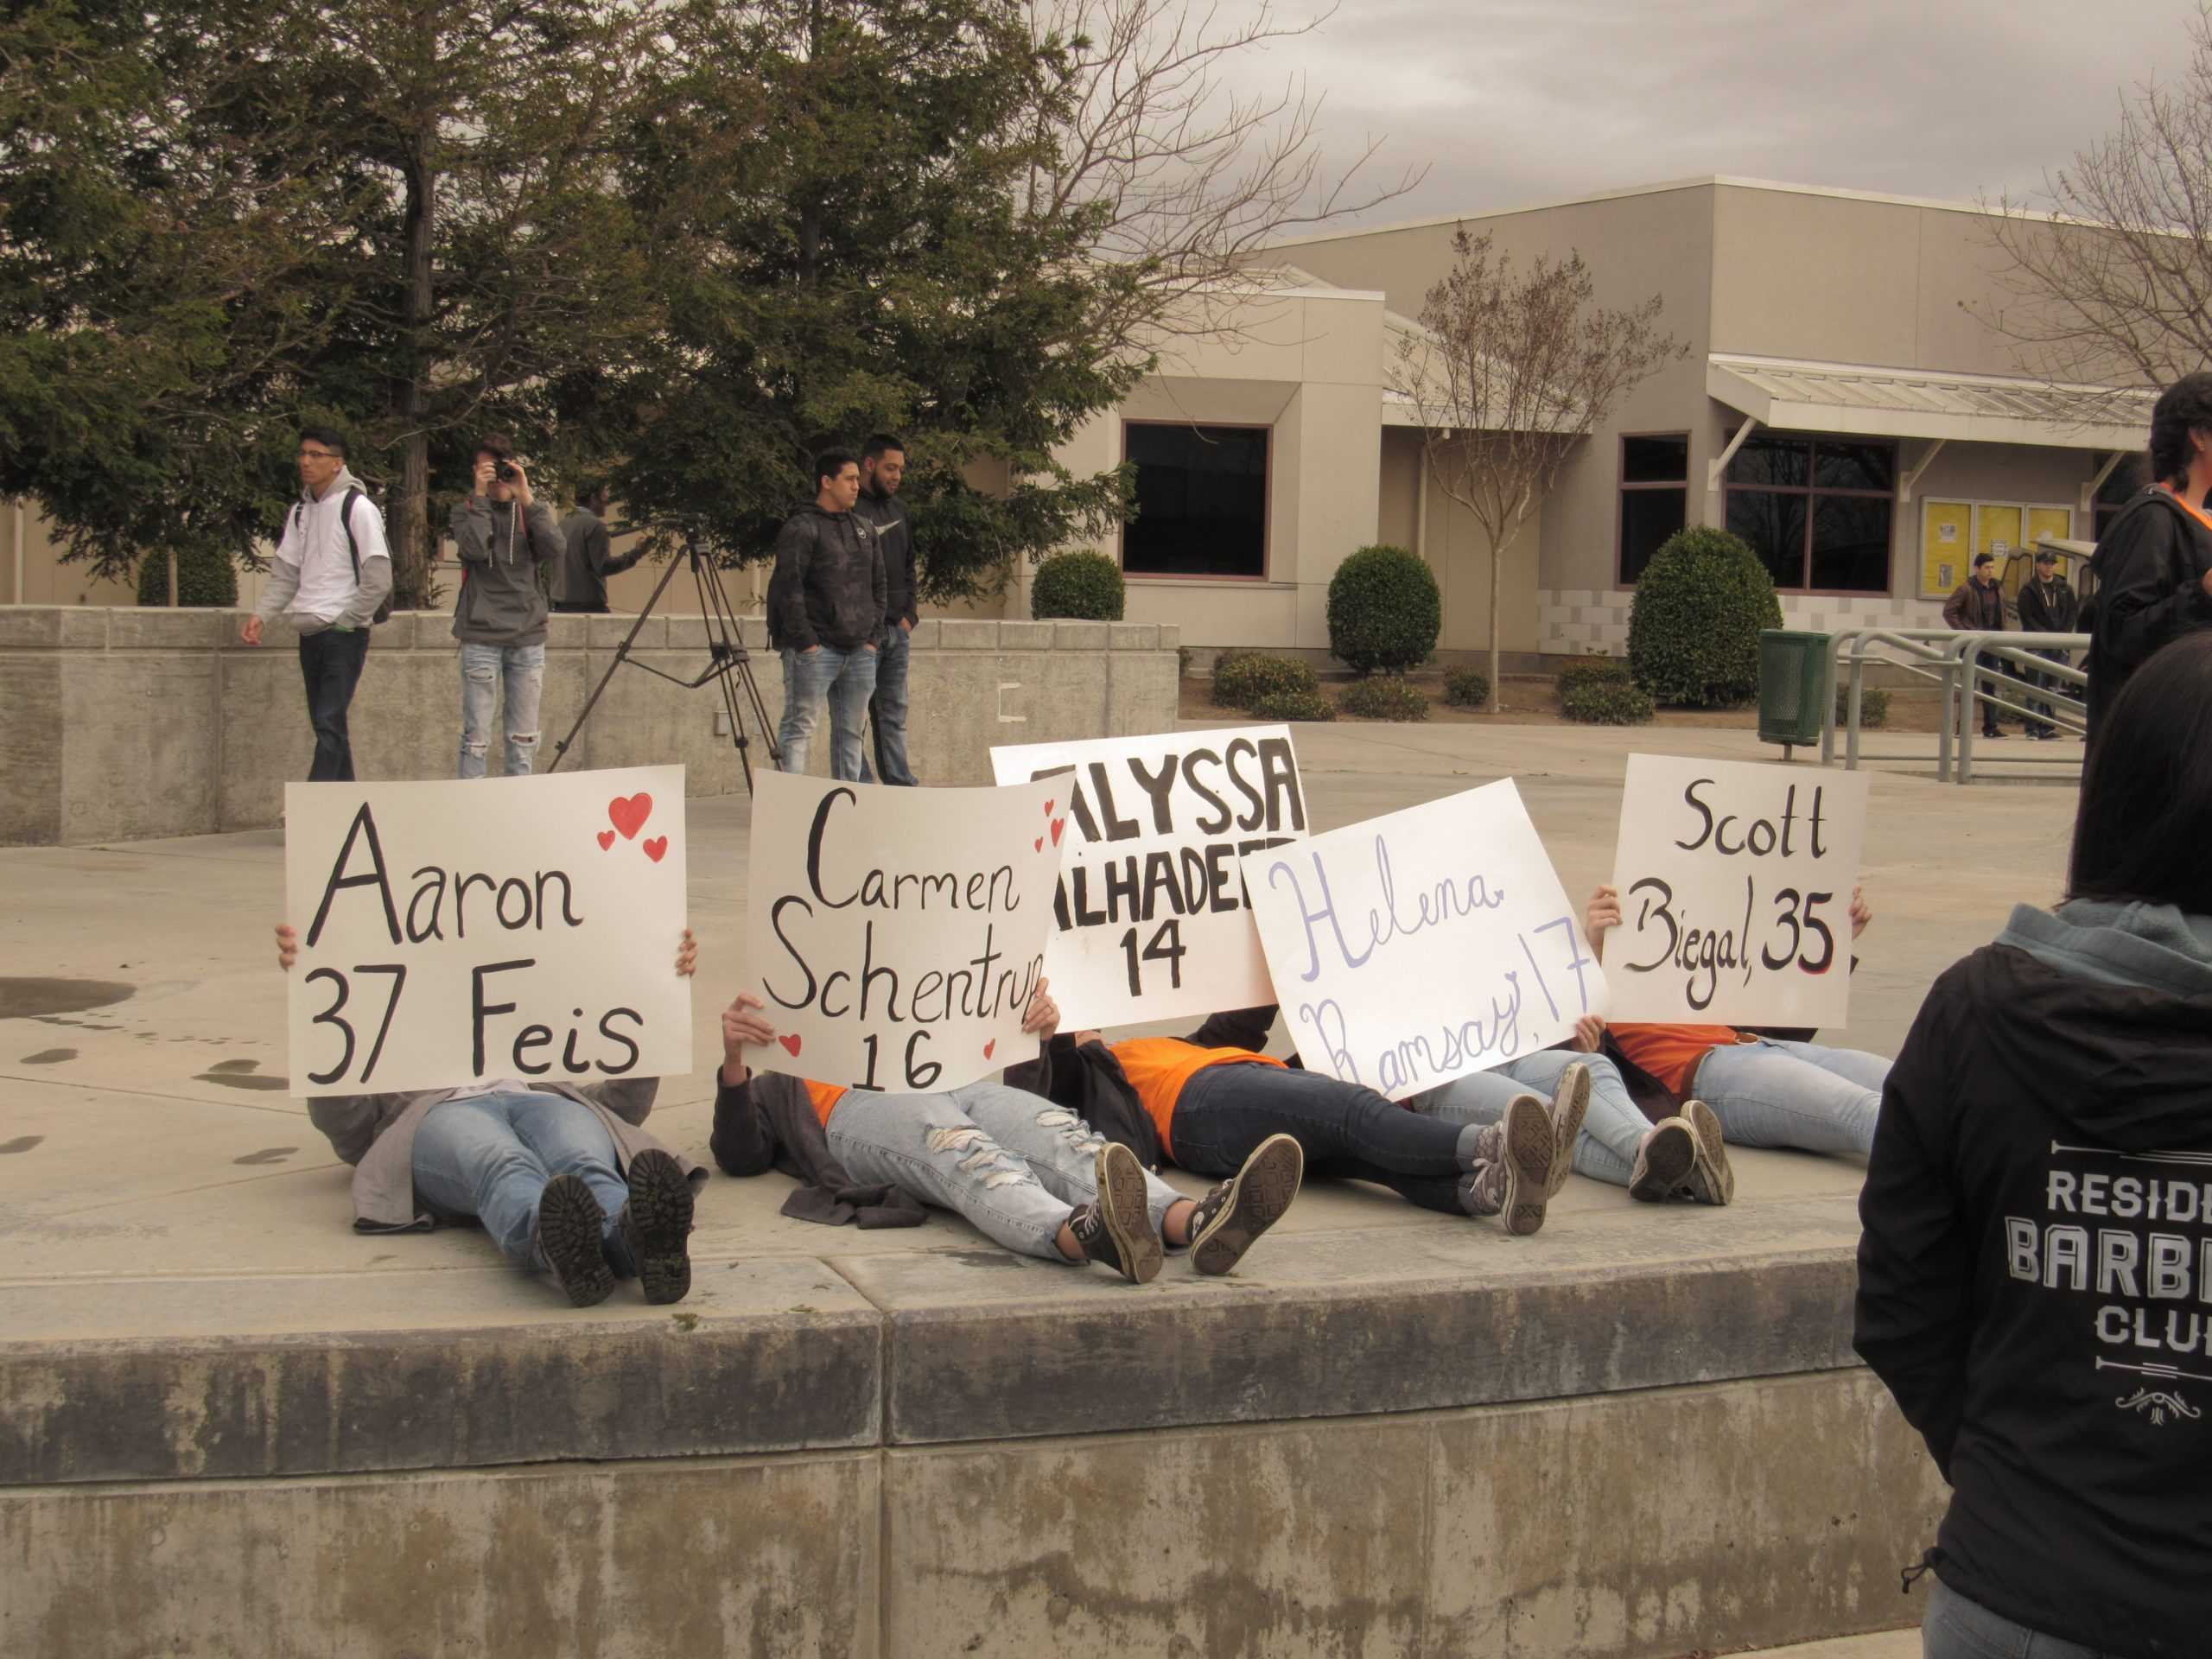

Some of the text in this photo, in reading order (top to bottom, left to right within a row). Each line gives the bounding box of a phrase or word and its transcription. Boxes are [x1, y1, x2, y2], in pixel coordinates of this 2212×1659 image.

[806, 786, 1021, 913] Carmen
[1674, 779, 1827, 859] Scott
[306, 800, 584, 947] Aaron
[1053, 837, 1297, 931] LHADE
[1268, 834, 1504, 982] Helena
[762, 894, 1045, 1026] Schentrup
[1119, 918, 1187, 997] 14
[1518, 916, 1591, 1023] 17
[1761, 887, 1834, 976] 35
[304, 958, 645, 1086] 37 Feis
[851, 1029, 943, 1092] 16
[2045, 1169, 2212, 1224] RESID
[2094, 1305, 2212, 1357] CLU
